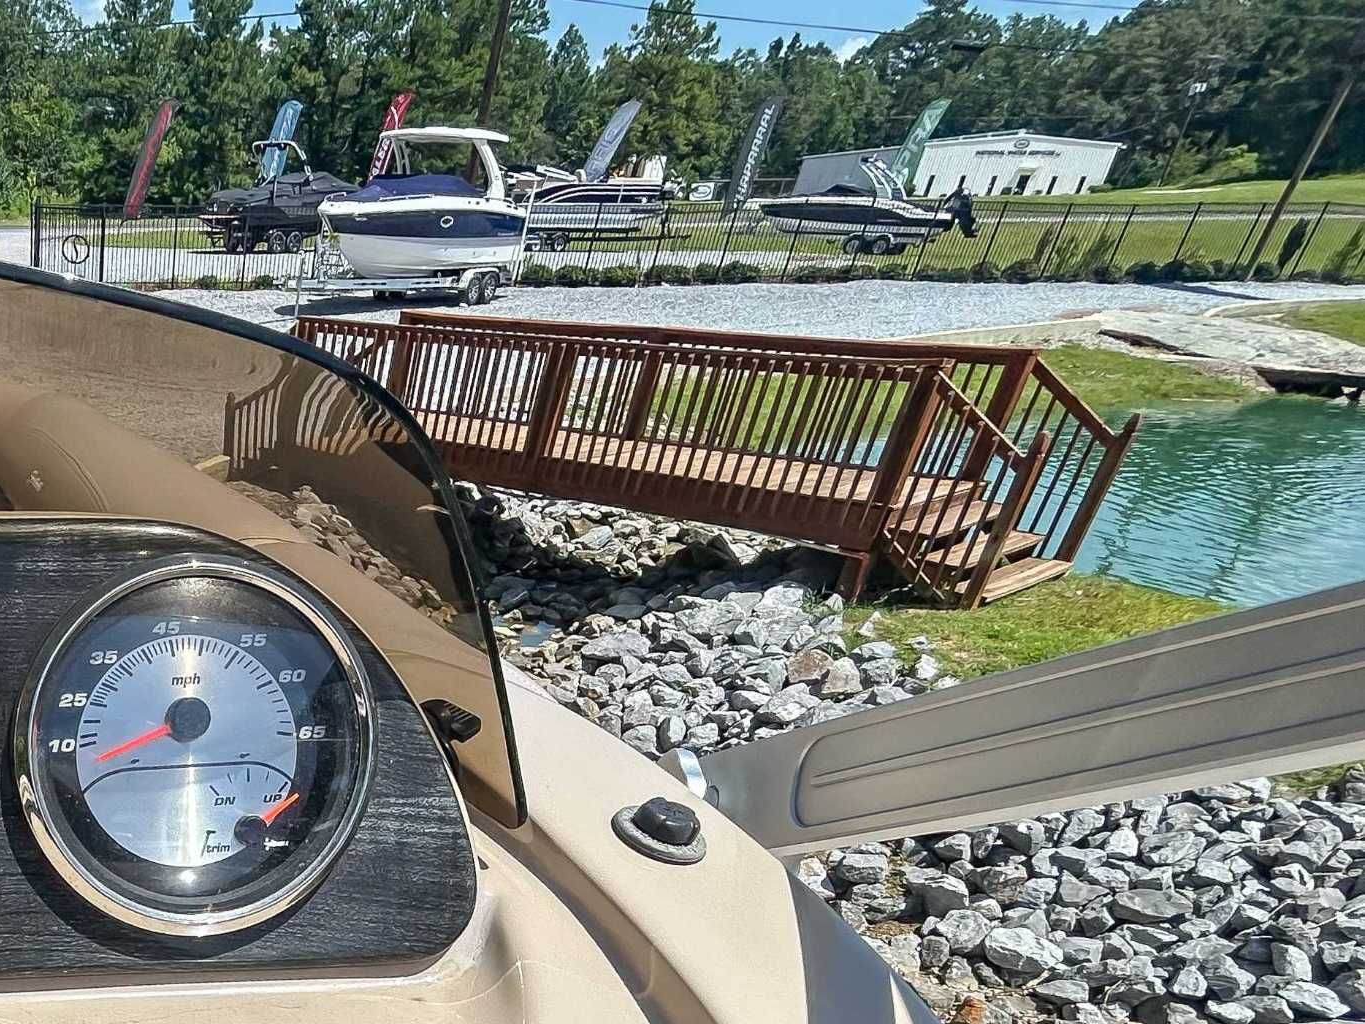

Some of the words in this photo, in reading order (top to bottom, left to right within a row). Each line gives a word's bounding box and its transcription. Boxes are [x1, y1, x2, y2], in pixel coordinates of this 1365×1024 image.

[152, 621, 181, 635] 45
[239, 633, 267, 647] 55
[89, 650, 118, 665] 35
[171, 673, 201, 688] mph
[278, 669, 306, 683] 60
[58, 693, 88, 708] 25
[298, 725, 326, 740] 65
[48, 739, 76, 753] 10
[214, 796, 236, 807] DN
[263, 793, 283, 804] UP
[206, 842, 231, 853] trim
